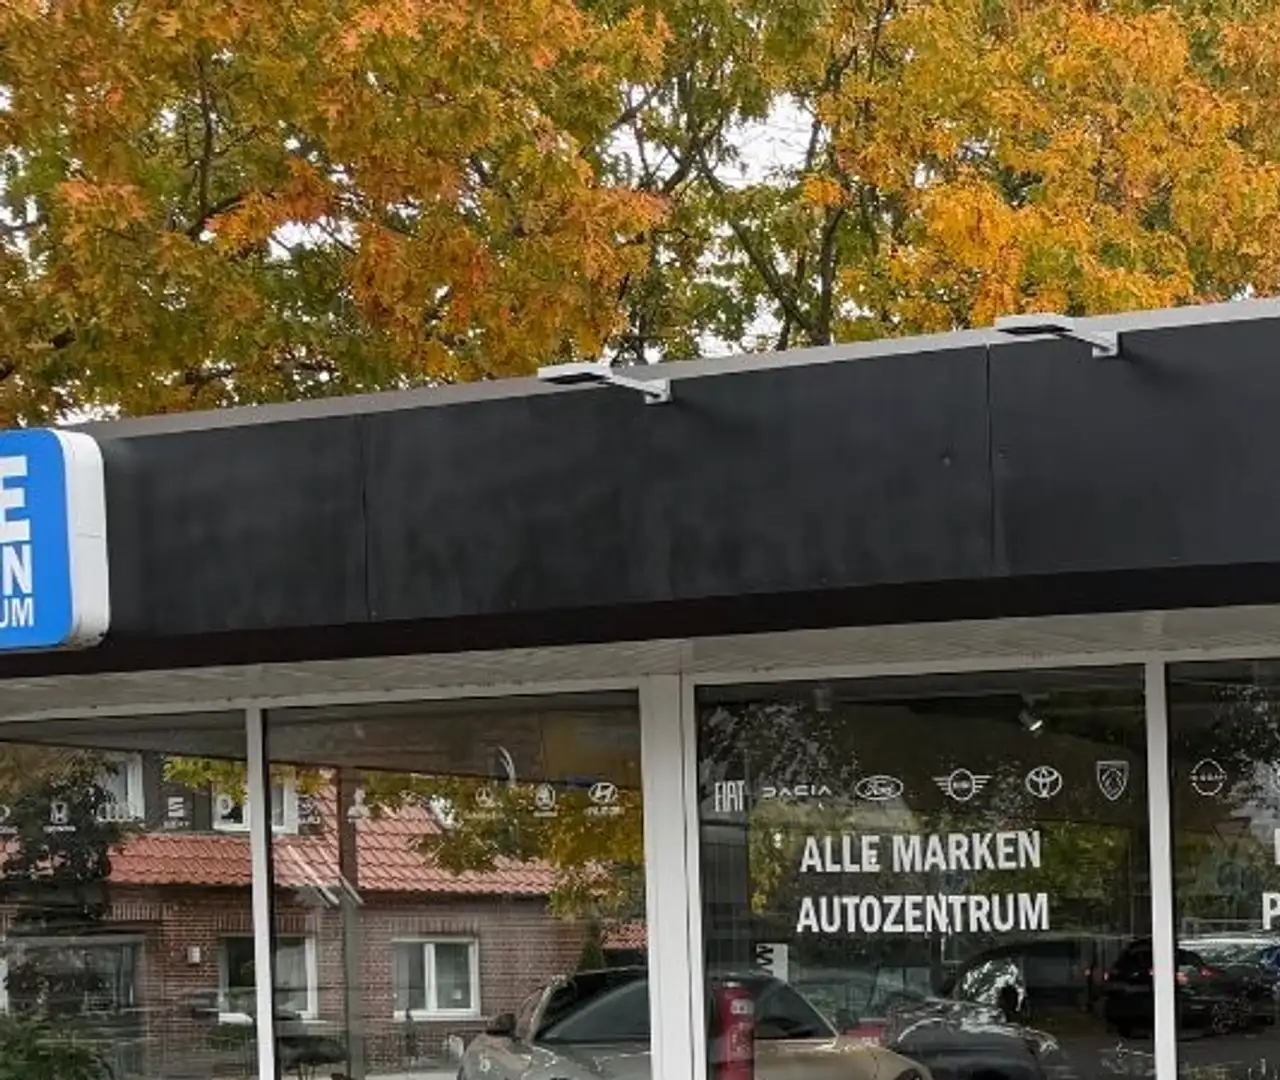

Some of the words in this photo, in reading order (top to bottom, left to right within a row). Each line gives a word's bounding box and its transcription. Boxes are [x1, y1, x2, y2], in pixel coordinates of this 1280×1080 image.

[714, 780, 745, 813] FIAT
[800, 834, 881, 873] ALLE
[892, 830, 1041, 872] MARKEN
[797, 893, 1050, 933] AUTOZENTRUM
